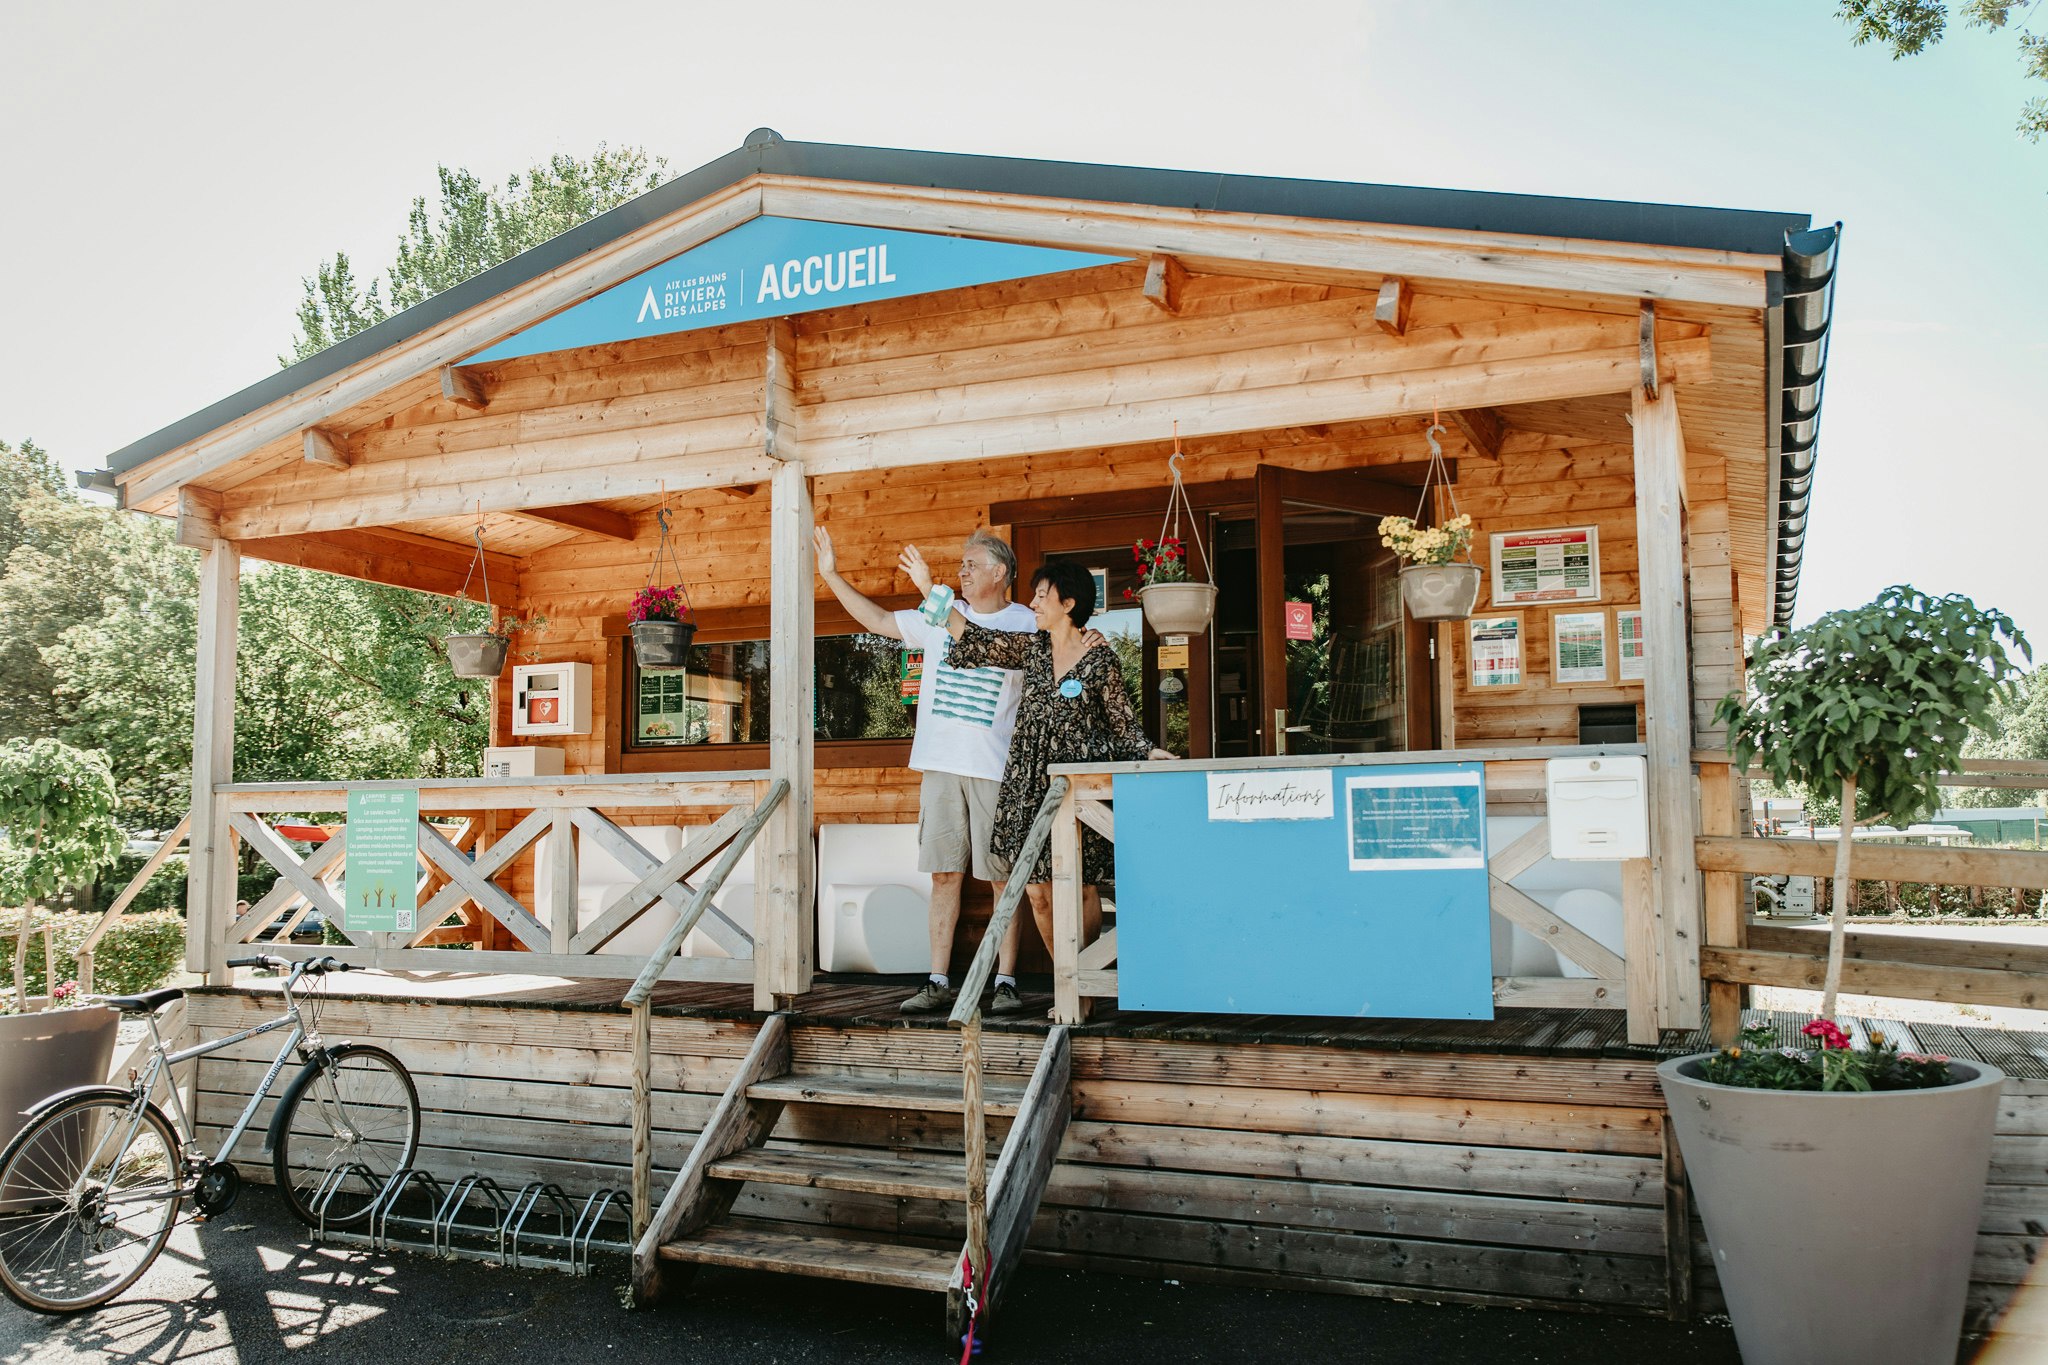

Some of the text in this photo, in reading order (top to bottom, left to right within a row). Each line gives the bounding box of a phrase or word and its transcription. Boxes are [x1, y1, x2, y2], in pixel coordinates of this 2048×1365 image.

[666, 272, 727, 290] AIX LES BAINS
[756, 244, 897, 304] ACCUEIL
[665, 284, 726, 306] RIVIERA
[664, 299, 726, 319] DES ALPES
[1216, 782, 1325, 815] Informations
